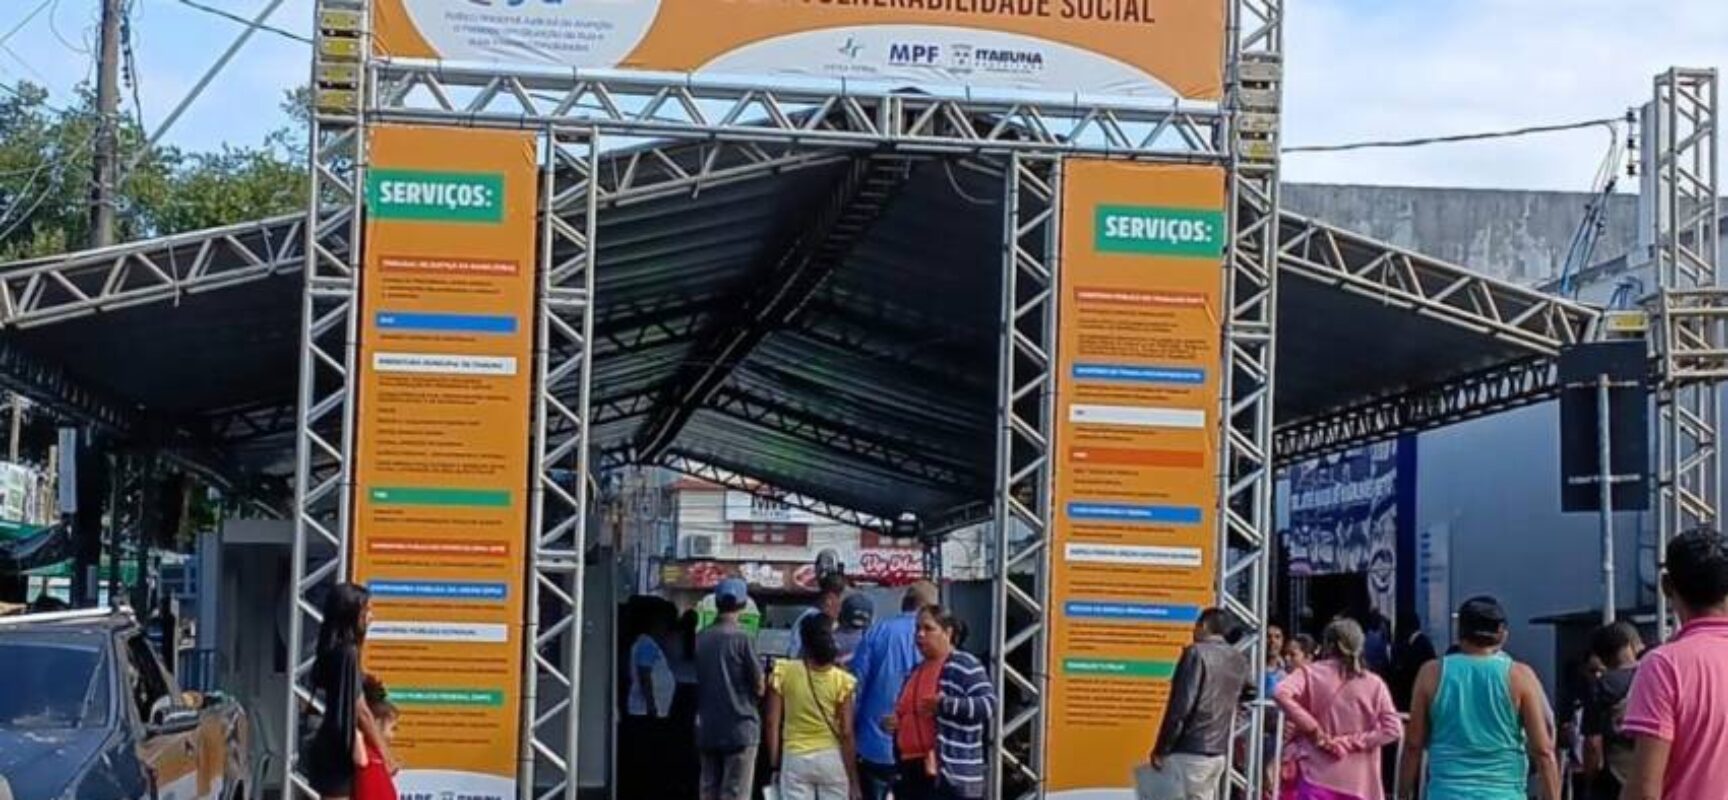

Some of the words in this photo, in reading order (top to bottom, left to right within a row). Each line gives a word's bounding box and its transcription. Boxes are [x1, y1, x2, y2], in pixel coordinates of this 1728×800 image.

[1060, 0, 1156, 23] SOCIAL
[889, 43, 940, 63] MPF
[974, 48, 1043, 65] ITABUNA
[379, 181, 494, 210] SERVIÇOS:
[1105, 215, 1213, 244] SERVIÇOS:
